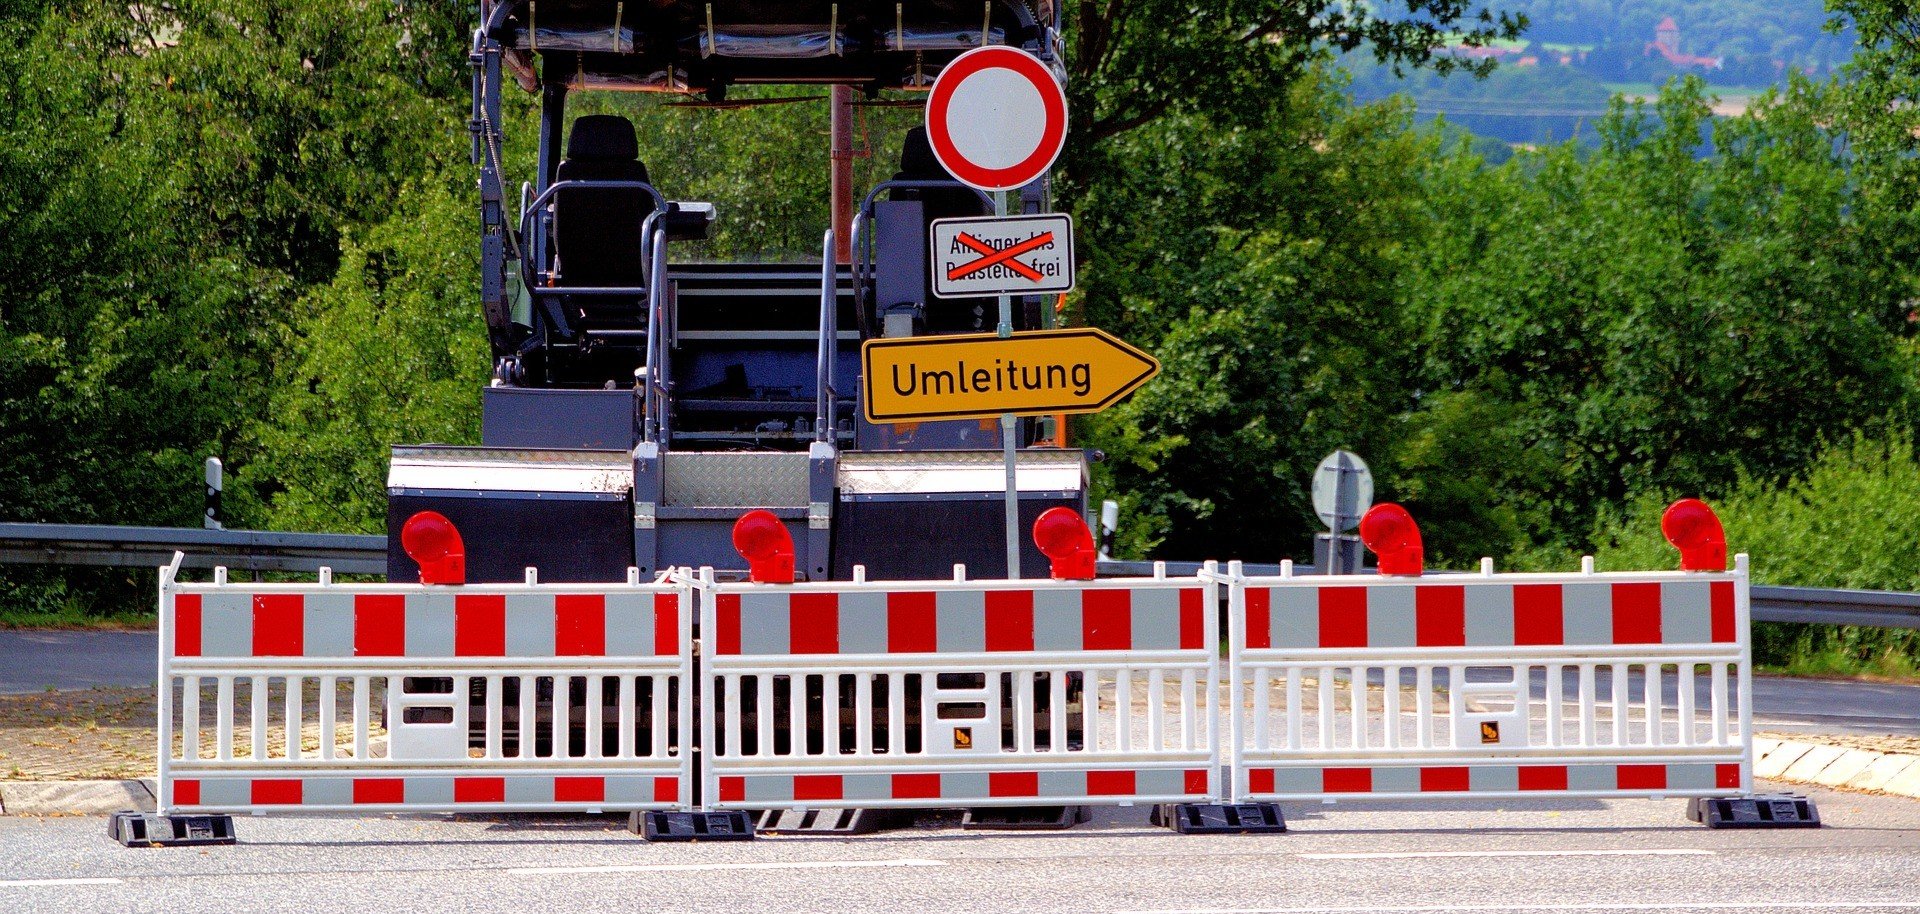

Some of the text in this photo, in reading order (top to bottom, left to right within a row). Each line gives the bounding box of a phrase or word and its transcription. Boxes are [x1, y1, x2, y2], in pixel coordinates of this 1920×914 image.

[950, 233, 1021, 255] Aneger
[946, 257, 1060, 281] ustell frei
[892, 358, 1091, 397] Umleitung
